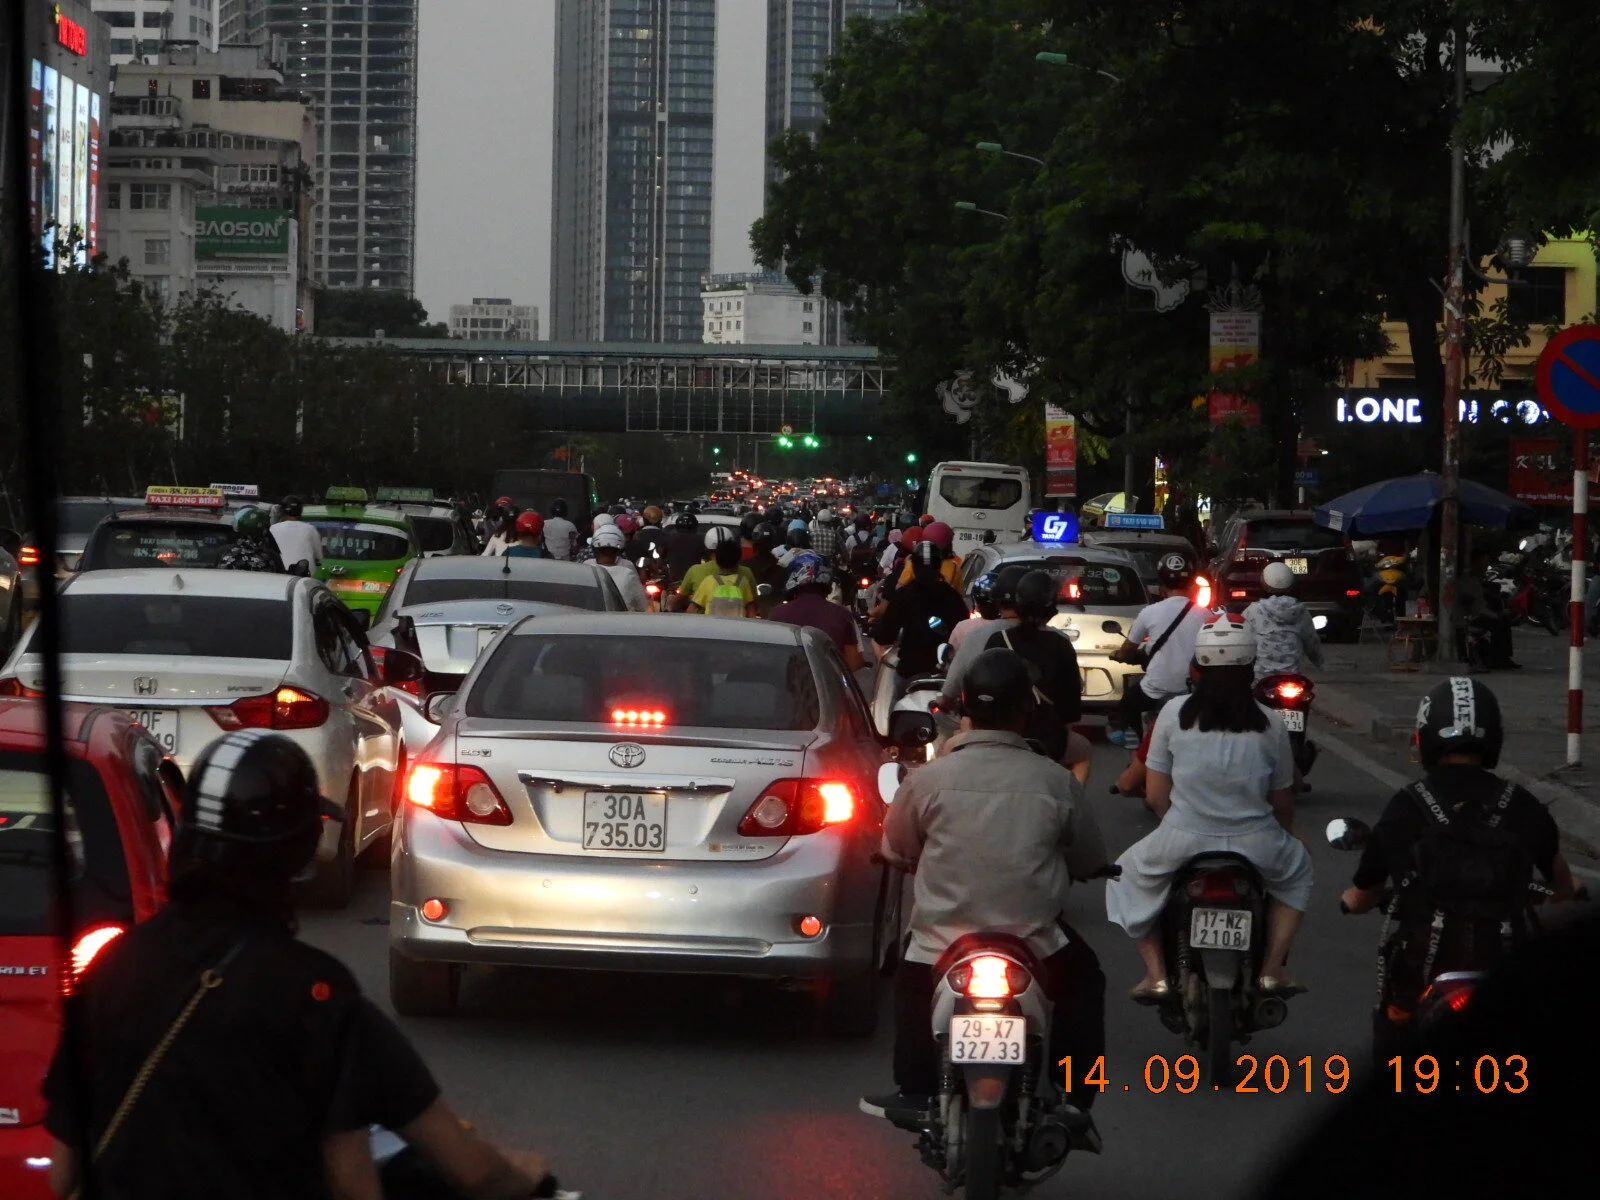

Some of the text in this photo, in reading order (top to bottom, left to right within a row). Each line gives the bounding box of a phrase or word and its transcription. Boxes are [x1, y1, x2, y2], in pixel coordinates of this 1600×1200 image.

[150, 495, 172, 503] TAXI
[1455, 680, 1471, 723] STYLE
[603, 795, 647, 821] 30A
[586, 822, 663, 850] 735.03
[1202, 911, 1244, 930] 17-N2
[1199, 928, 1242, 947] 2108
[962, 1018, 1015, 1040] 29-X7
[954, 1041, 1021, 1061] 327.33
